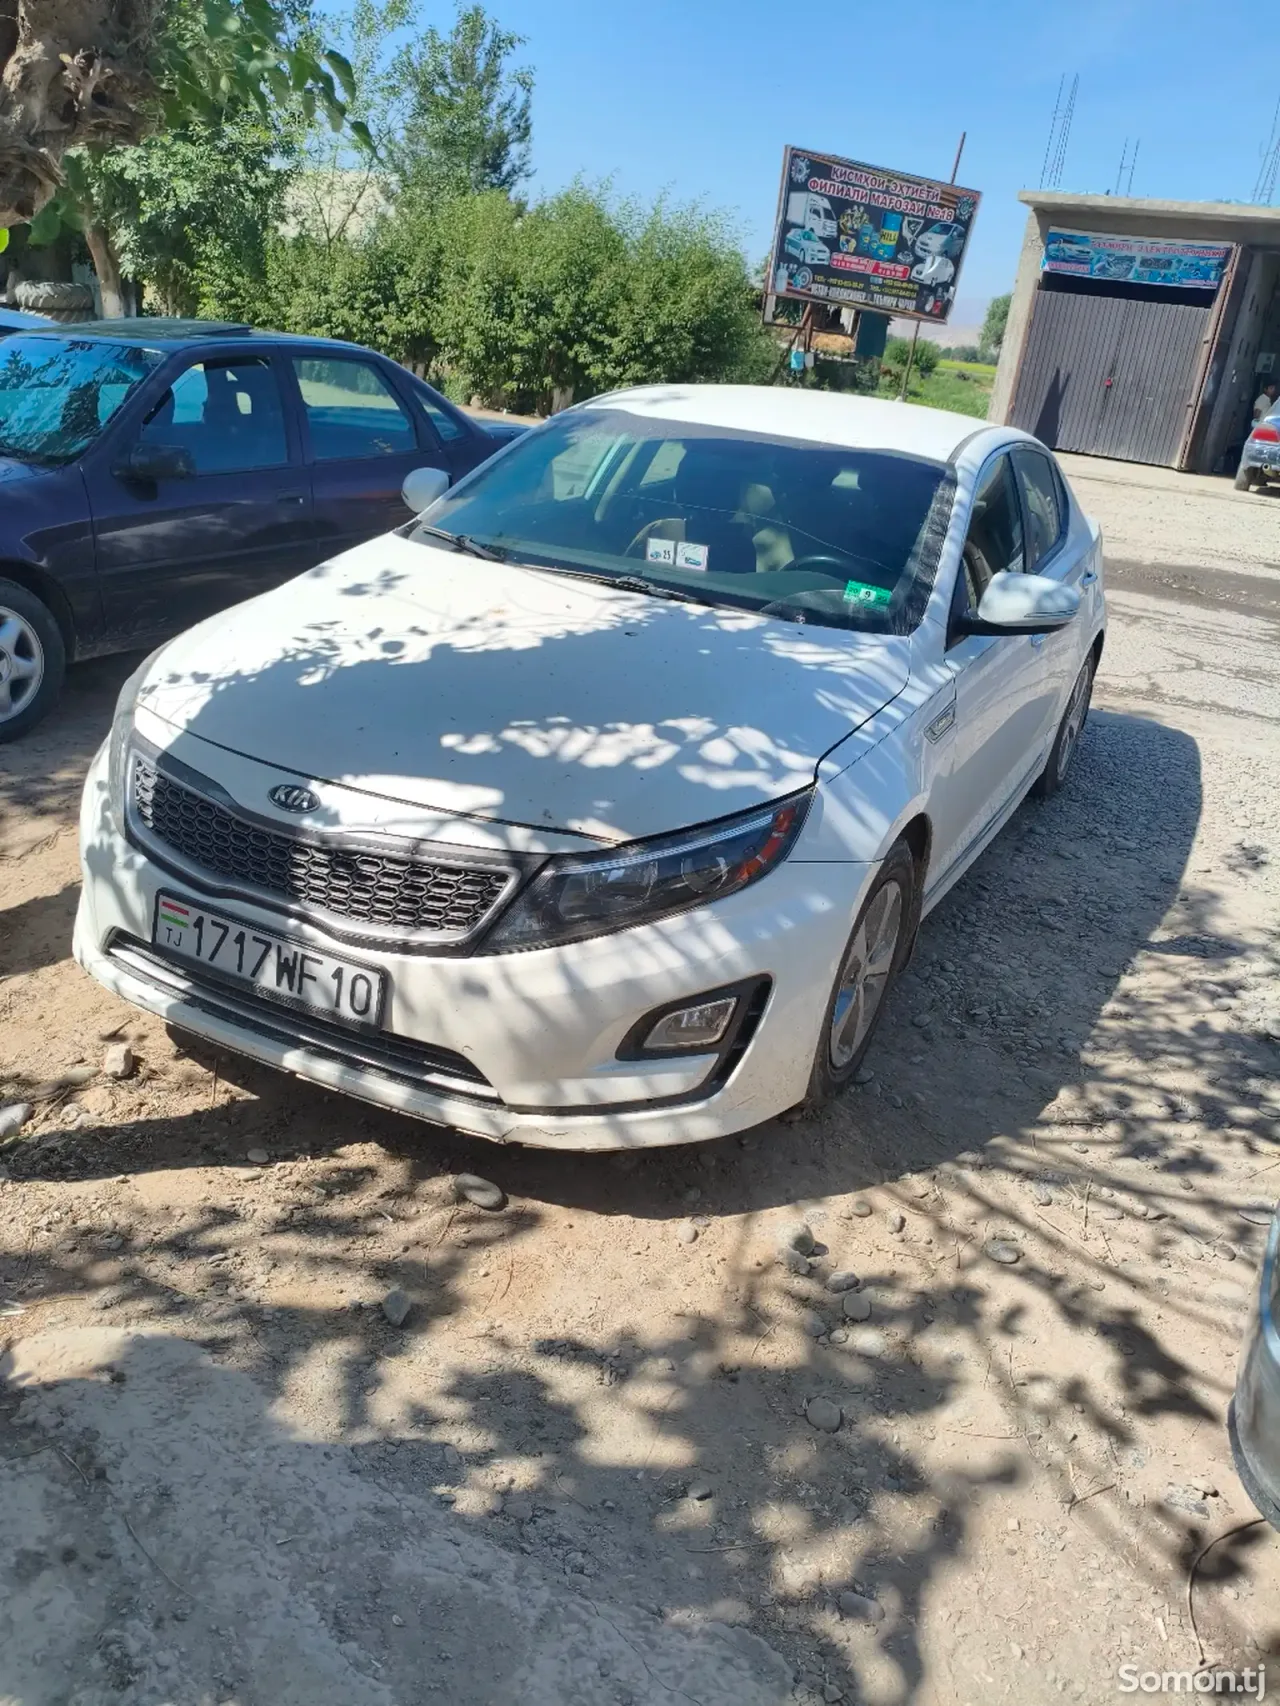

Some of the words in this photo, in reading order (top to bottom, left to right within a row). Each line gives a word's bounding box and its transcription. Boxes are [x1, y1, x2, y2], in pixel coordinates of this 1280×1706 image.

[808, 177, 869, 204] ФИЛИАЛИ
[273, 786, 311, 809] KIA
[166, 927, 183, 948] TJ
